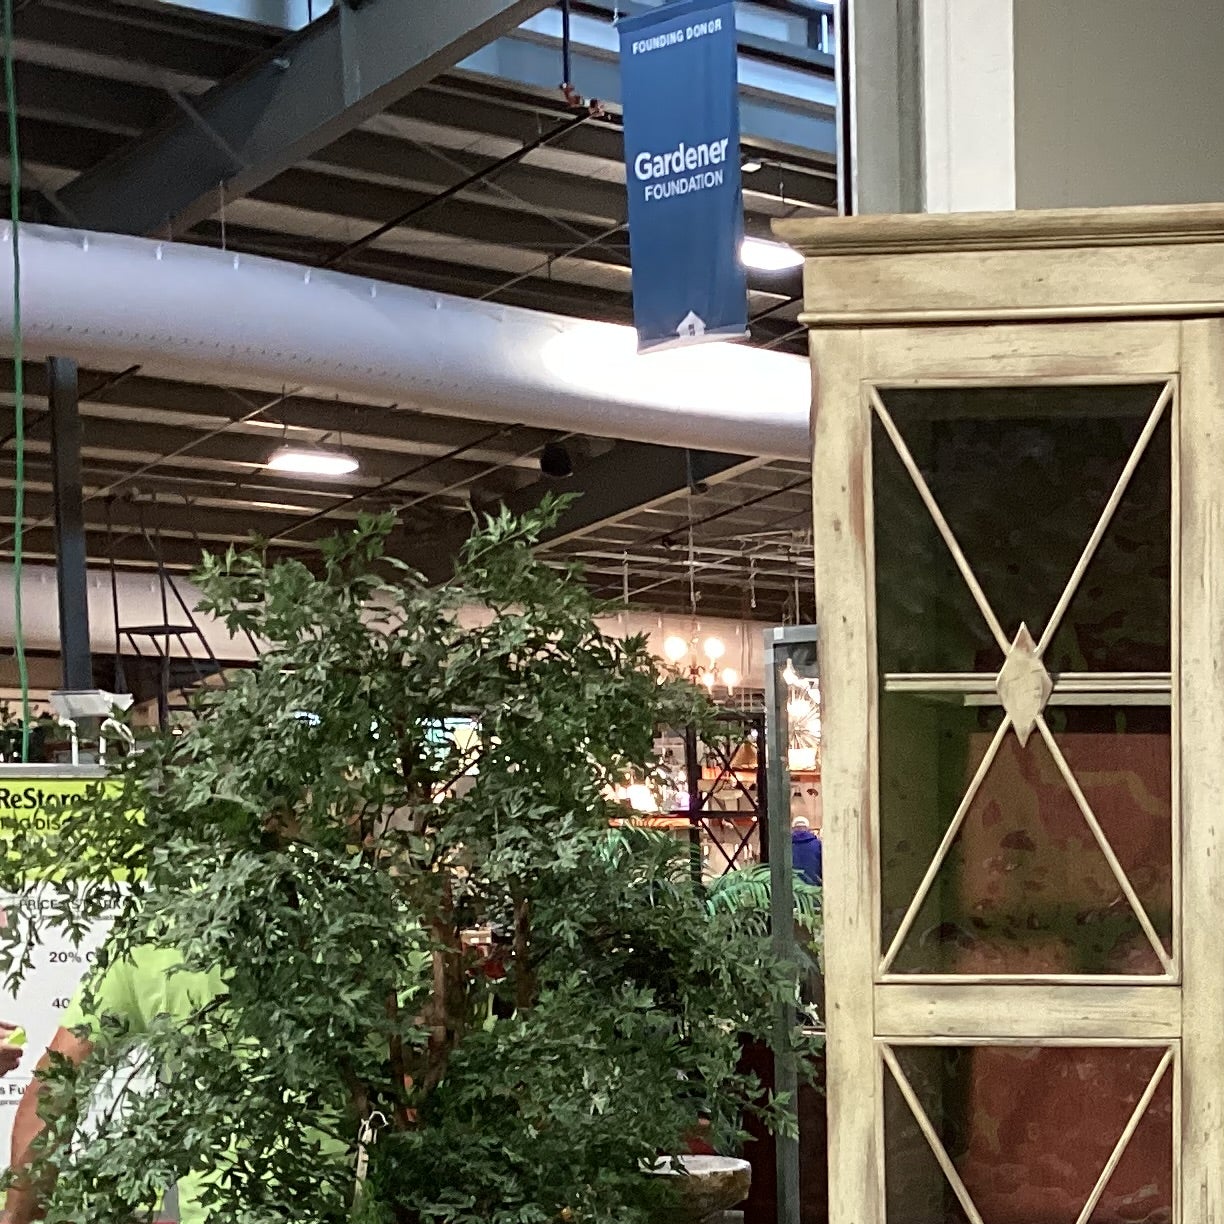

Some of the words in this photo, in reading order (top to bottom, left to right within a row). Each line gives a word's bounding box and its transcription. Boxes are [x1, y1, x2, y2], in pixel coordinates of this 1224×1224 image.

[632, 30, 684, 55] FOUNDING
[686, 18, 722, 40] DONOR
[634, 137, 729, 180] Gardener
[645, 169, 723, 201] FOUNDATION
[49, 951, 82, 963] 20%
[52, 997, 70, 1009] 40
